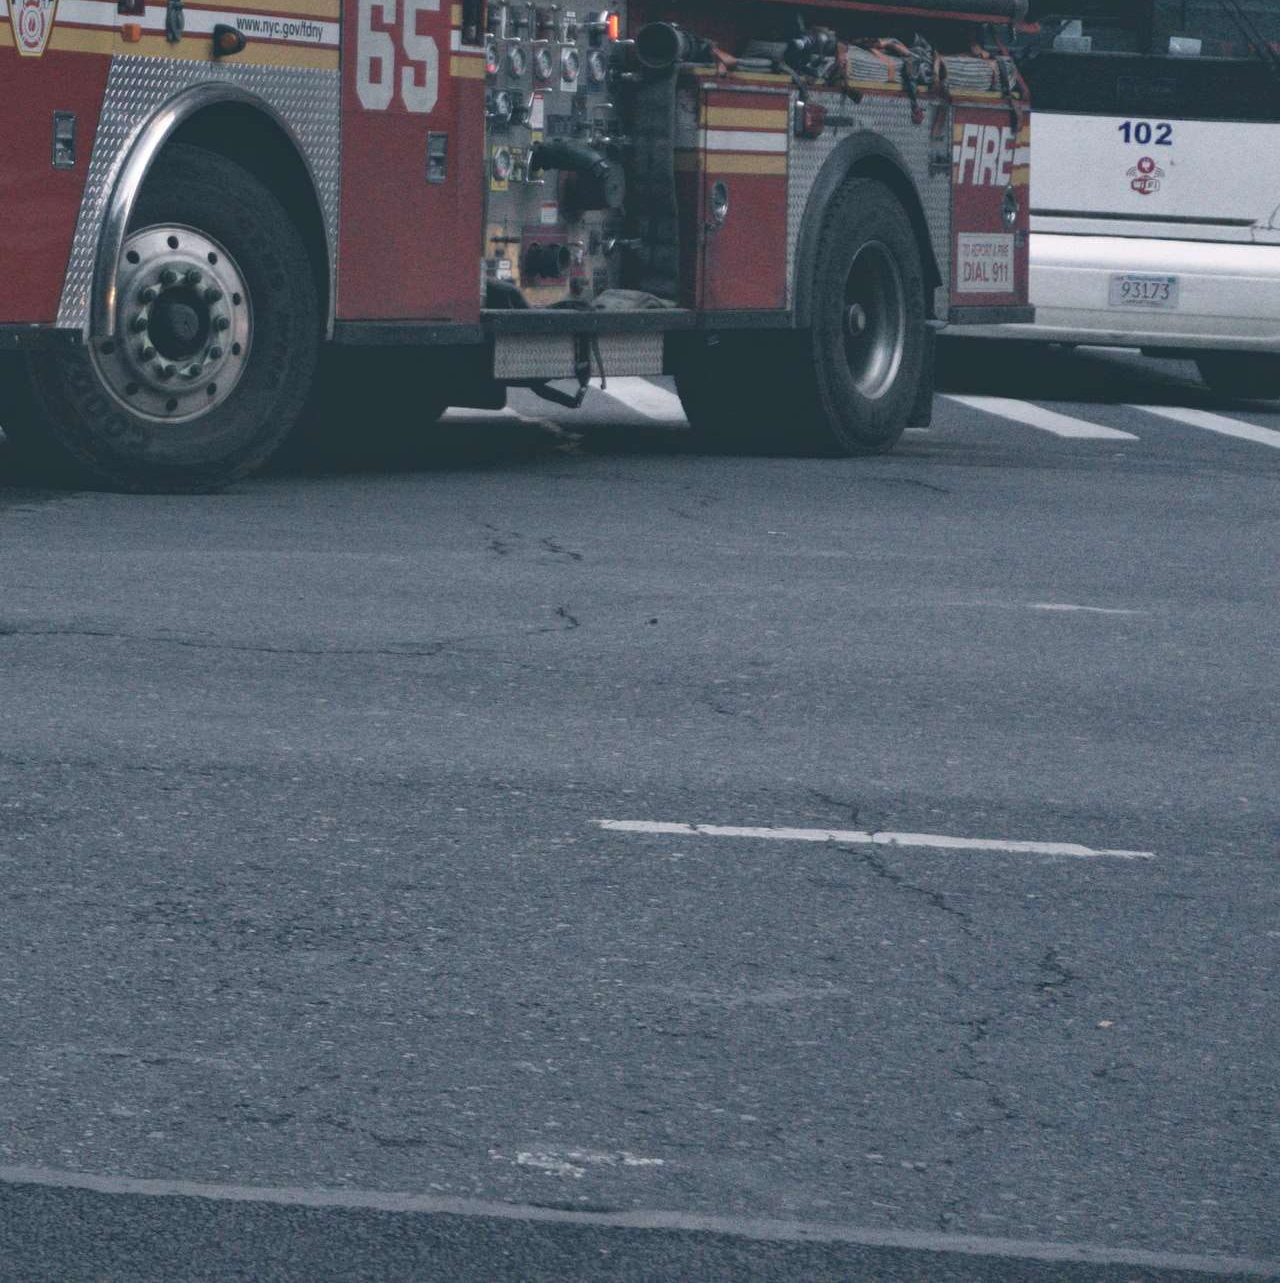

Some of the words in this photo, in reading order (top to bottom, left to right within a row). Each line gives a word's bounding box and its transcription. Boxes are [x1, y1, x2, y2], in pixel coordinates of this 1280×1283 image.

[236, 16, 325, 42] www.nyc.gov/fdny
[1118, 120, 1174, 146] 102
[957, 123, 1015, 186] FIRE
[963, 262, 990, 283] DIAL
[992, 262, 1009, 283] 911
[1120, 282, 1170, 300] 93173
